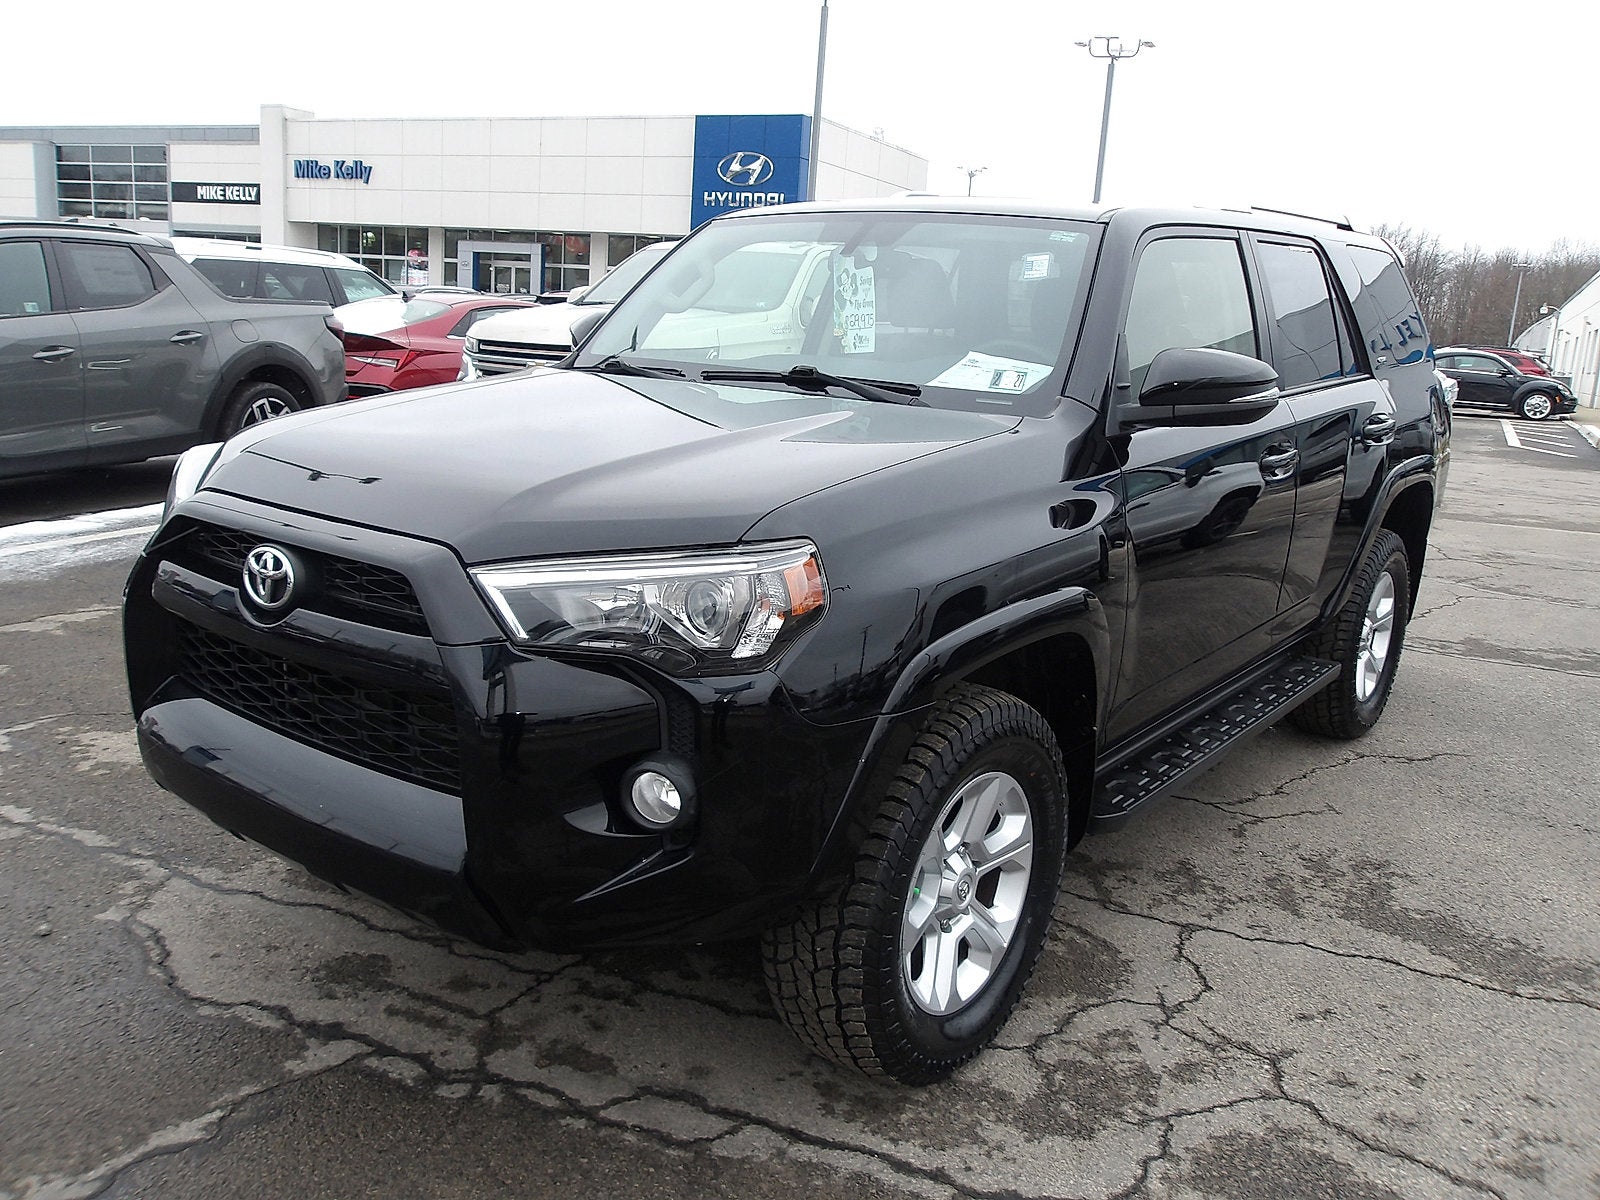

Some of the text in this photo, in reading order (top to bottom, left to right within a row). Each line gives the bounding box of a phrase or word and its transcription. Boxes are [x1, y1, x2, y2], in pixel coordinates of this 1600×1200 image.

[293, 159, 373, 185] Mike Kelly
[197, 185, 258, 201] MIKE KELLY
[703, 191, 785, 208] HYUNDAI
[992, 371, 1002, 386] 2
[1013, 374, 1025, 388] 27
